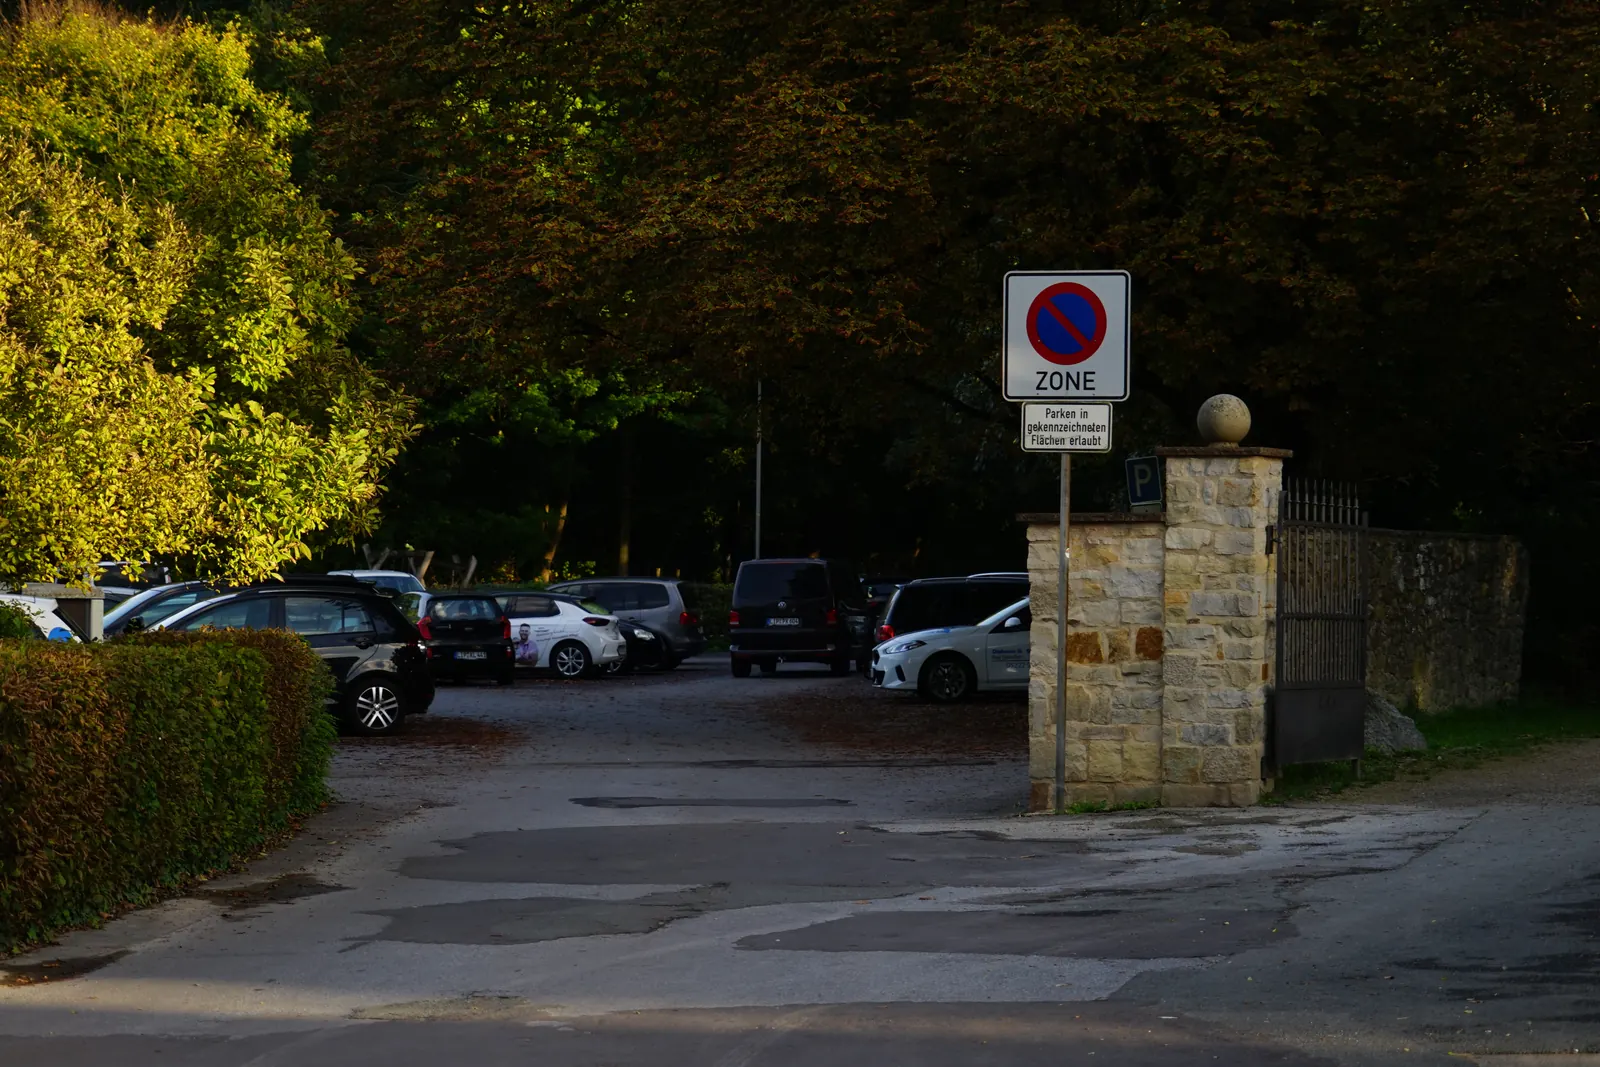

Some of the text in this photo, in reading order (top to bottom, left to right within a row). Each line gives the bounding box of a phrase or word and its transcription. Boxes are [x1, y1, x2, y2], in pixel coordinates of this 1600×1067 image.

[1035, 371, 1096, 391] ZONE
[1045, 407, 1088, 419] Parken in
[1027, 421, 1106, 435] gekennzeichneten
[1031, 434, 1102, 446] Flächen erlaubt
[1133, 464, 1152, 498] P
